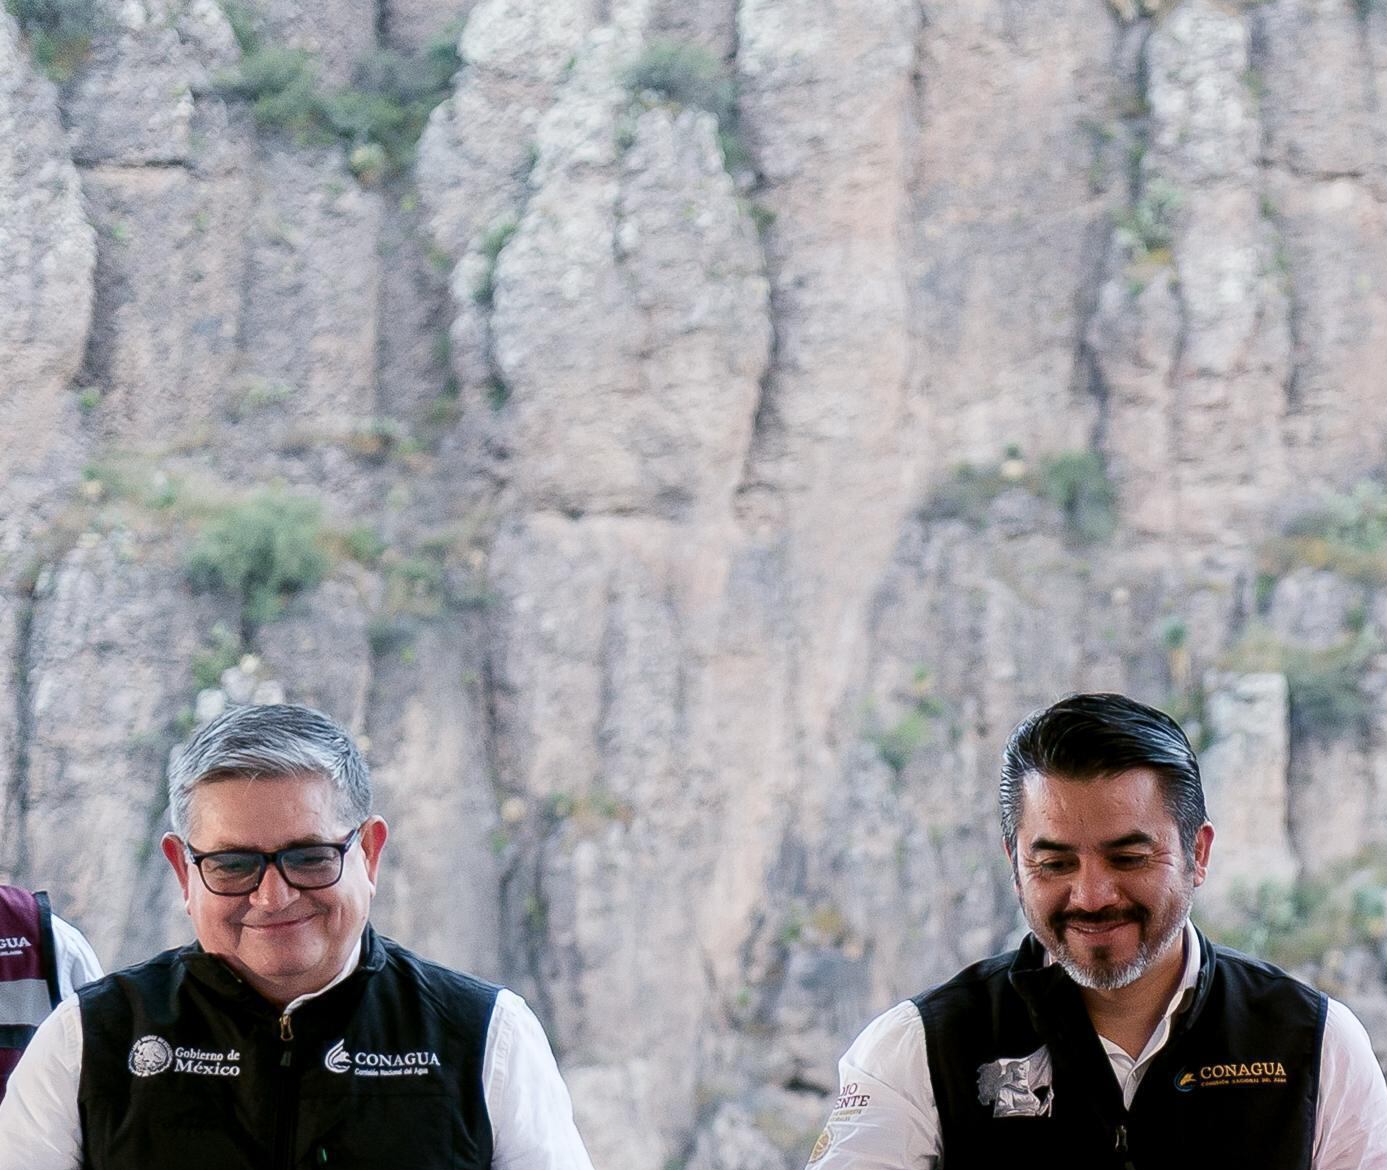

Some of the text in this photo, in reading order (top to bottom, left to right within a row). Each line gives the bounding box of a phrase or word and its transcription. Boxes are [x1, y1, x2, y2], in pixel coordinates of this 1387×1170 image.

[175, 1047, 241, 1061] Gobierno de
[355, 1051, 441, 1067] CONAGUA
[174, 1058, 241, 1076] México
[1200, 1062, 1287, 1079] CONAGUA
